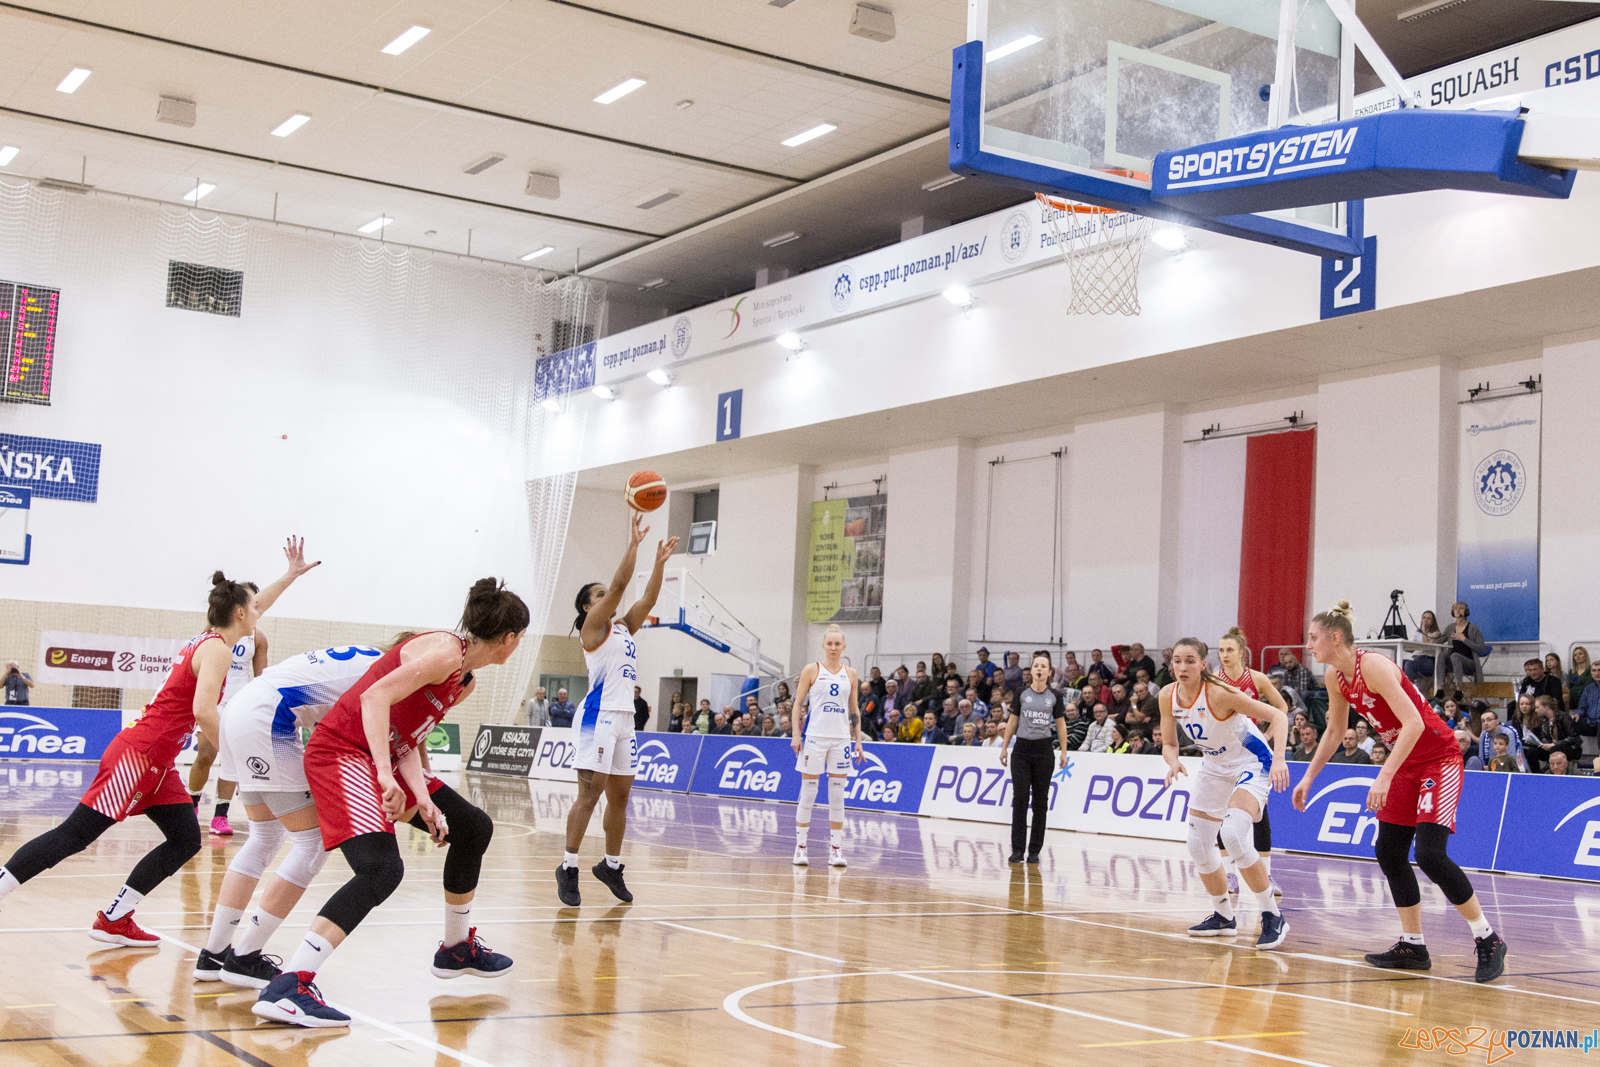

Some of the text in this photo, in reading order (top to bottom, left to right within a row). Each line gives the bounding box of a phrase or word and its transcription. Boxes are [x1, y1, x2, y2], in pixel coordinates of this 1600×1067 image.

[1430, 56, 1519, 106] SQUASH
[1168, 127, 1358, 180] SPORTSYSTEM
[859, 235, 988, 293] cspp.put.poznan.pl/azs/
[1334, 256, 1361, 308] 2
[603, 334, 667, 369] cspp.put.poznan.pl
[724, 396, 732, 436] 1
[625, 639, 636, 659] 32
[70, 653, 172, 668] Energa Basket
[140, 664, 159, 674] Liga
[623, 668, 637, 681] Ene
[829, 683, 840, 697] 8
[822, 705, 846, 714] Enea
[1185, 723, 1209, 741] 12
[489, 744, 535, 759] KTÓRE SIĘ CZYTA
[537, 740, 577, 770] POZ
[629, 739, 639, 757] 3
[844, 746, 853, 760] 8
[635, 755, 679, 788] Enea
[718, 761, 782, 797] Enea
